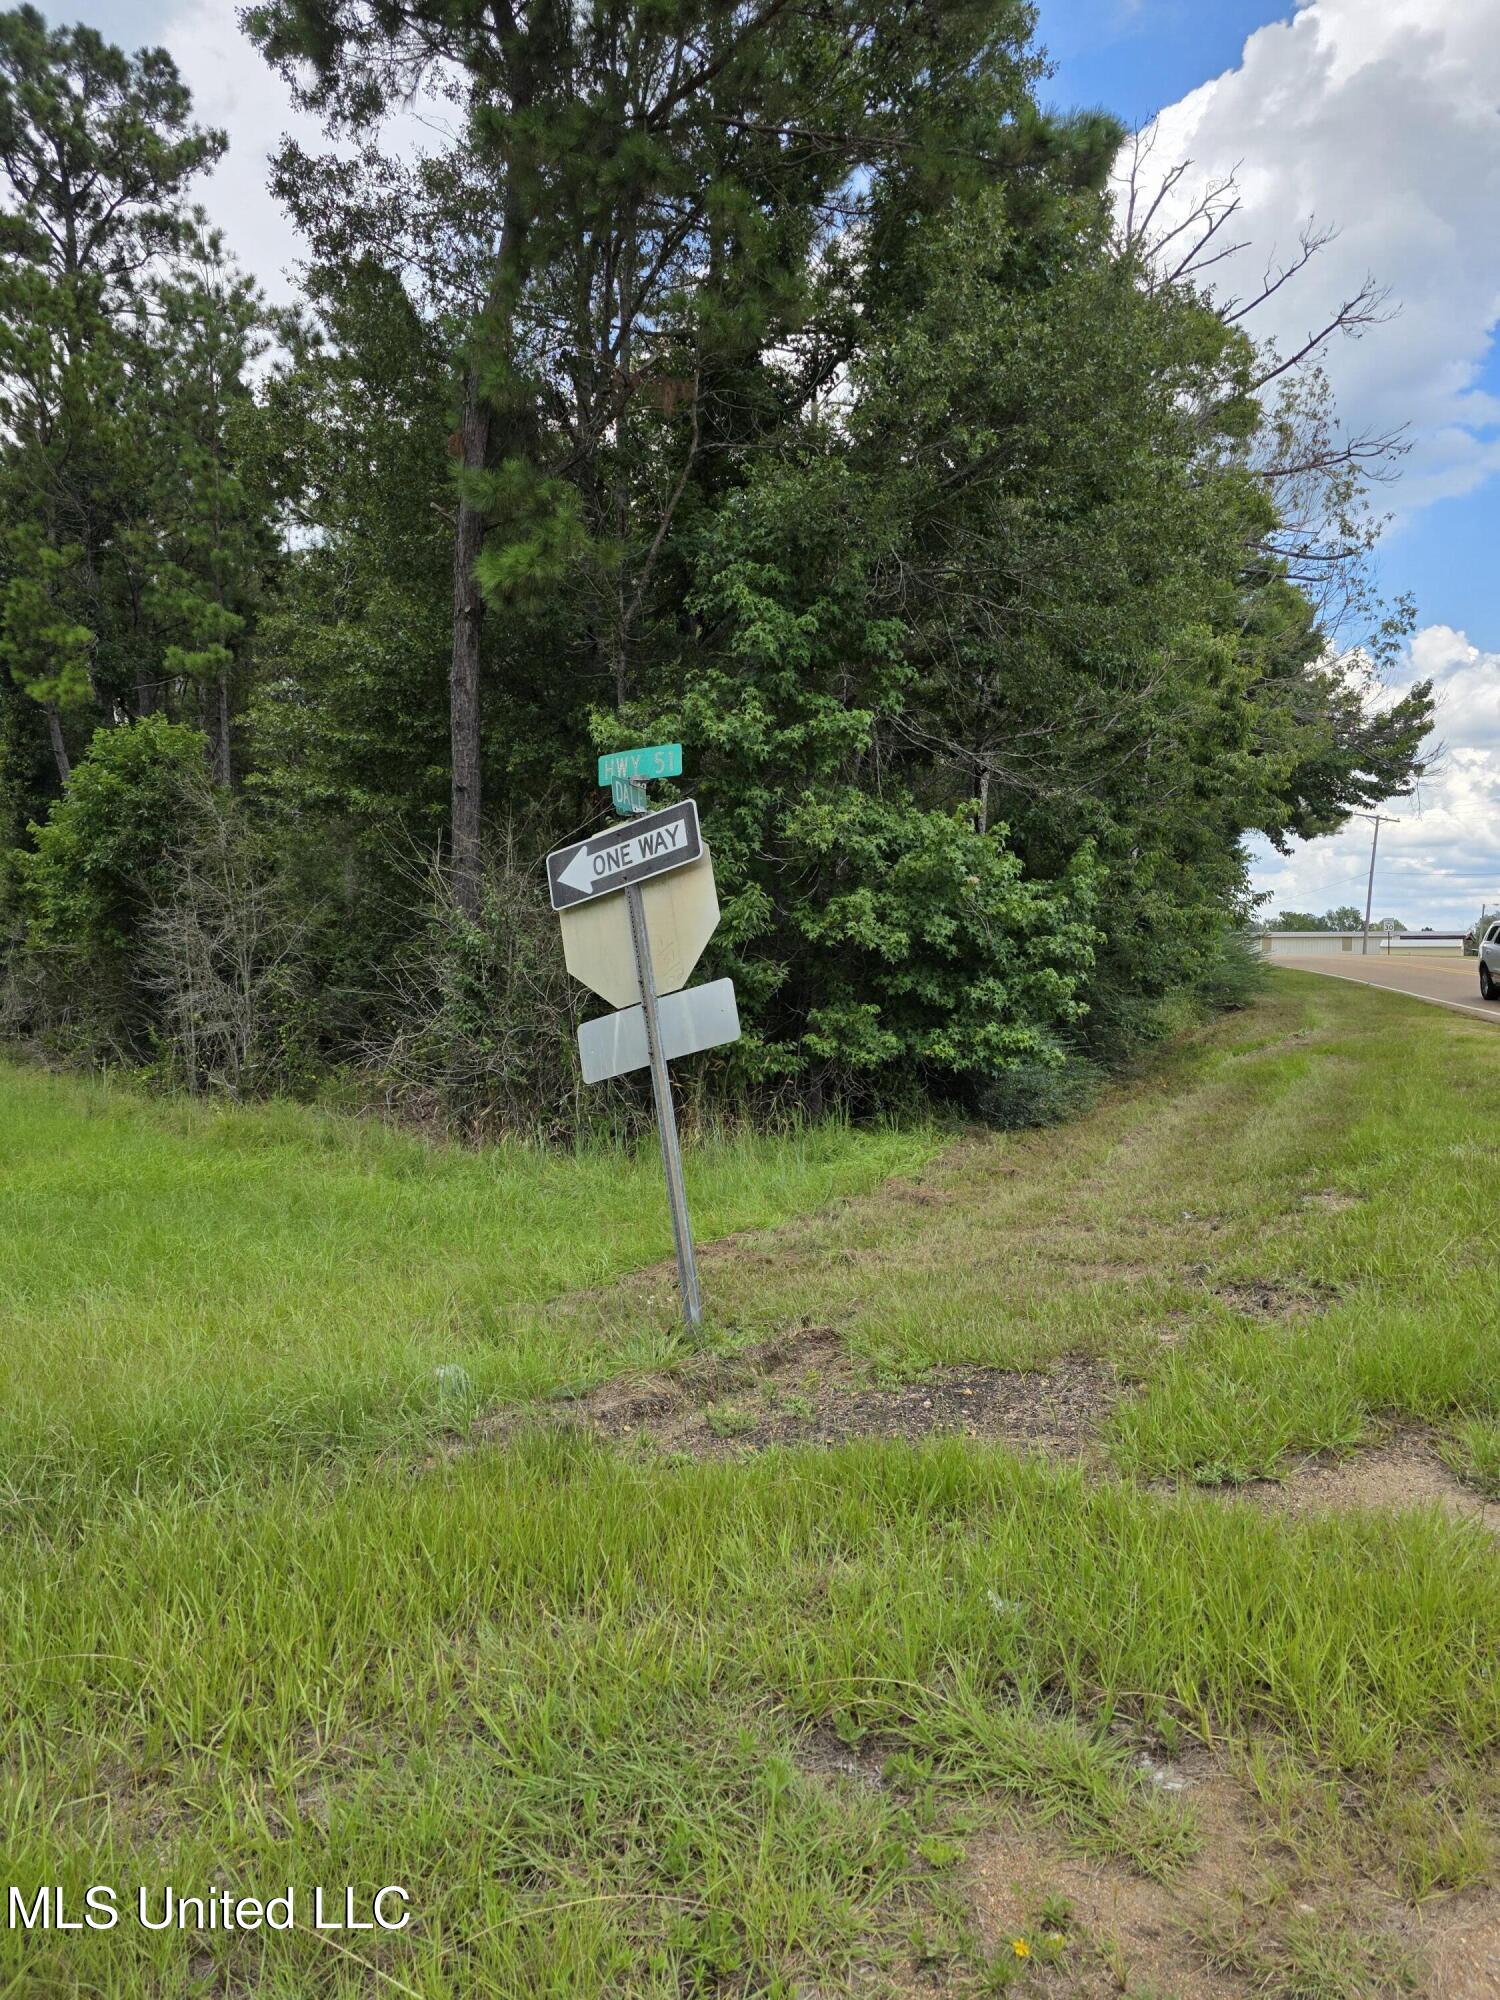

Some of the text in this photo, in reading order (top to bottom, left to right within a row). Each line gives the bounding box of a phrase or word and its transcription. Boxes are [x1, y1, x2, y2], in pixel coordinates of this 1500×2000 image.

[604, 751, 674, 779] HWY 51
[592, 823, 679, 876] ONE WAY
